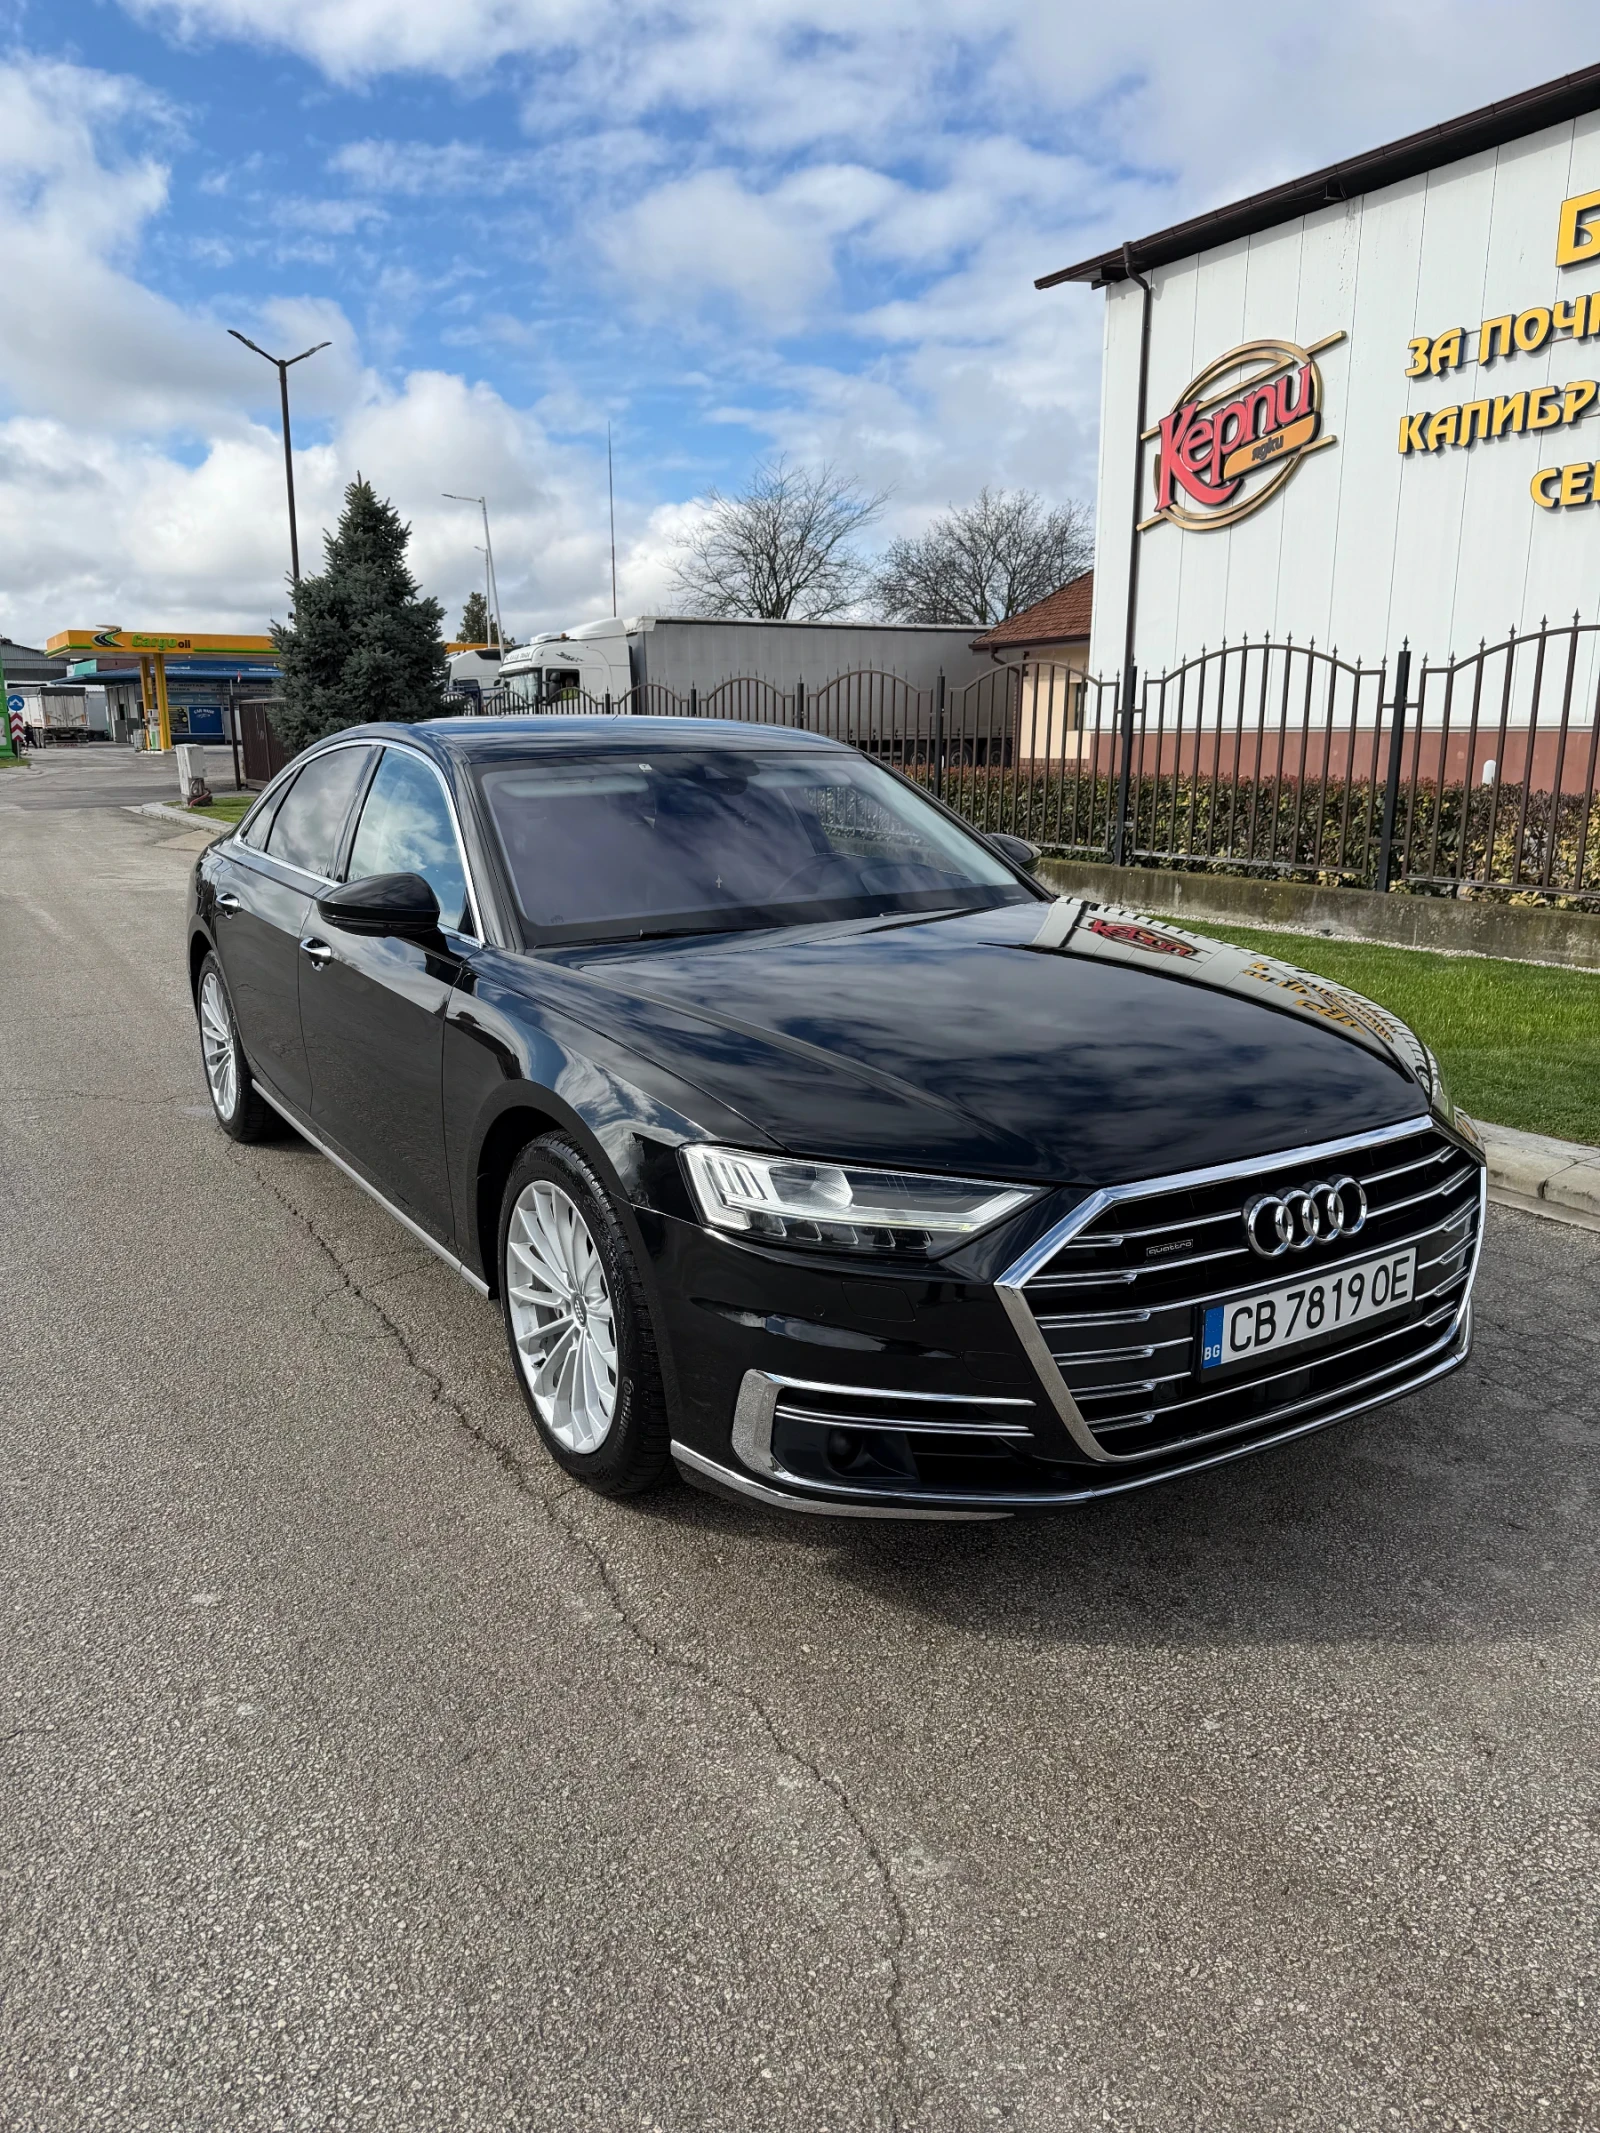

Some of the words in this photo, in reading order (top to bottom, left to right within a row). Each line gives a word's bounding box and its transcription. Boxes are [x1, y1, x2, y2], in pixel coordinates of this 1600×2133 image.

[1405, 327, 1464, 378] ЗА
[1154, 361, 1313, 512] Керпи
[1398, 380, 1600, 454] КАЛИБР
[1530, 460, 1600, 507] СЕ
[132, 634, 177, 651] Cargo
[178, 639, 191, 649] oil
[1149, 1241, 1192, 1255] quattro
[1204, 1343, 1221, 1361] BG
